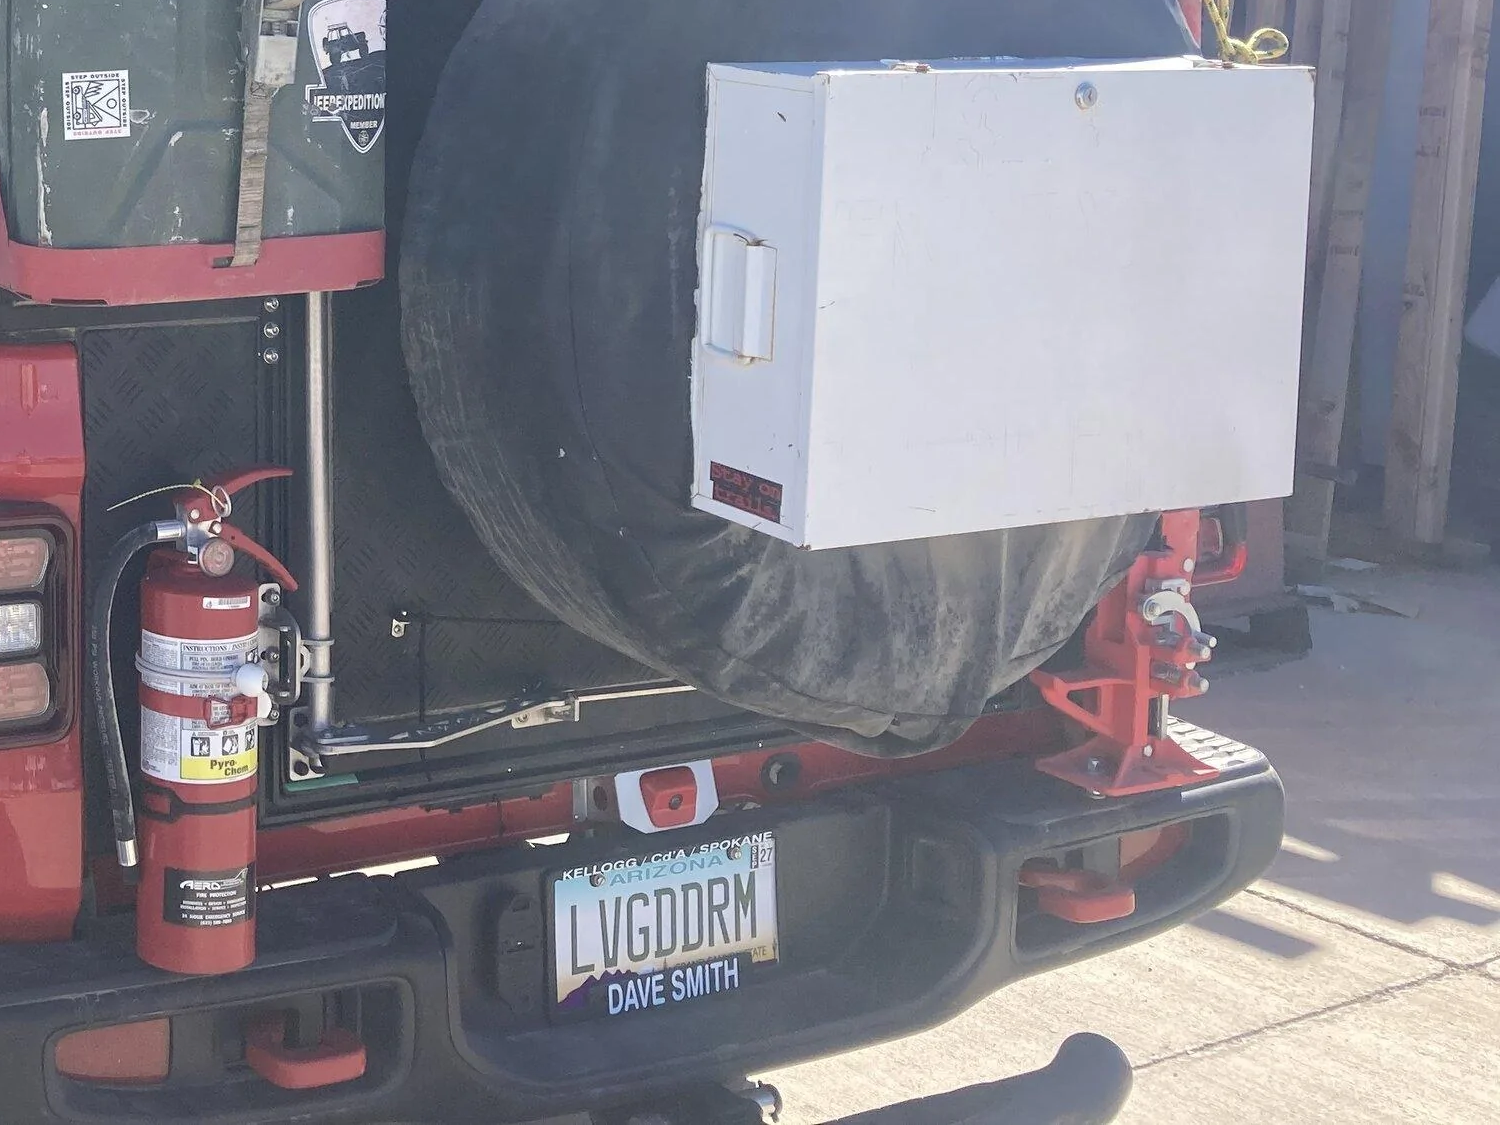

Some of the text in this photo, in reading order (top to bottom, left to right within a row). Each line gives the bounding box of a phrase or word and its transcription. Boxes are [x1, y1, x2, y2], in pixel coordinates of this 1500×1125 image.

[350, 120, 378, 129] MEMBER
[183, 645, 228, 653] INSTRUCTIONS
[224, 765, 249, 776] Chem
[563, 858, 637, 881] KELLOGG
[651, 849, 686, 863] Cd'A
[700, 831, 773, 854] SPOKANE
[760, 847, 772, 863] 27
[610, 856, 723, 887] ARIZONA
[180, 880, 221, 890] AERO
[570, 871, 757, 976] LVGDDRM
[608, 958, 739, 1015] DAVE SMITH
